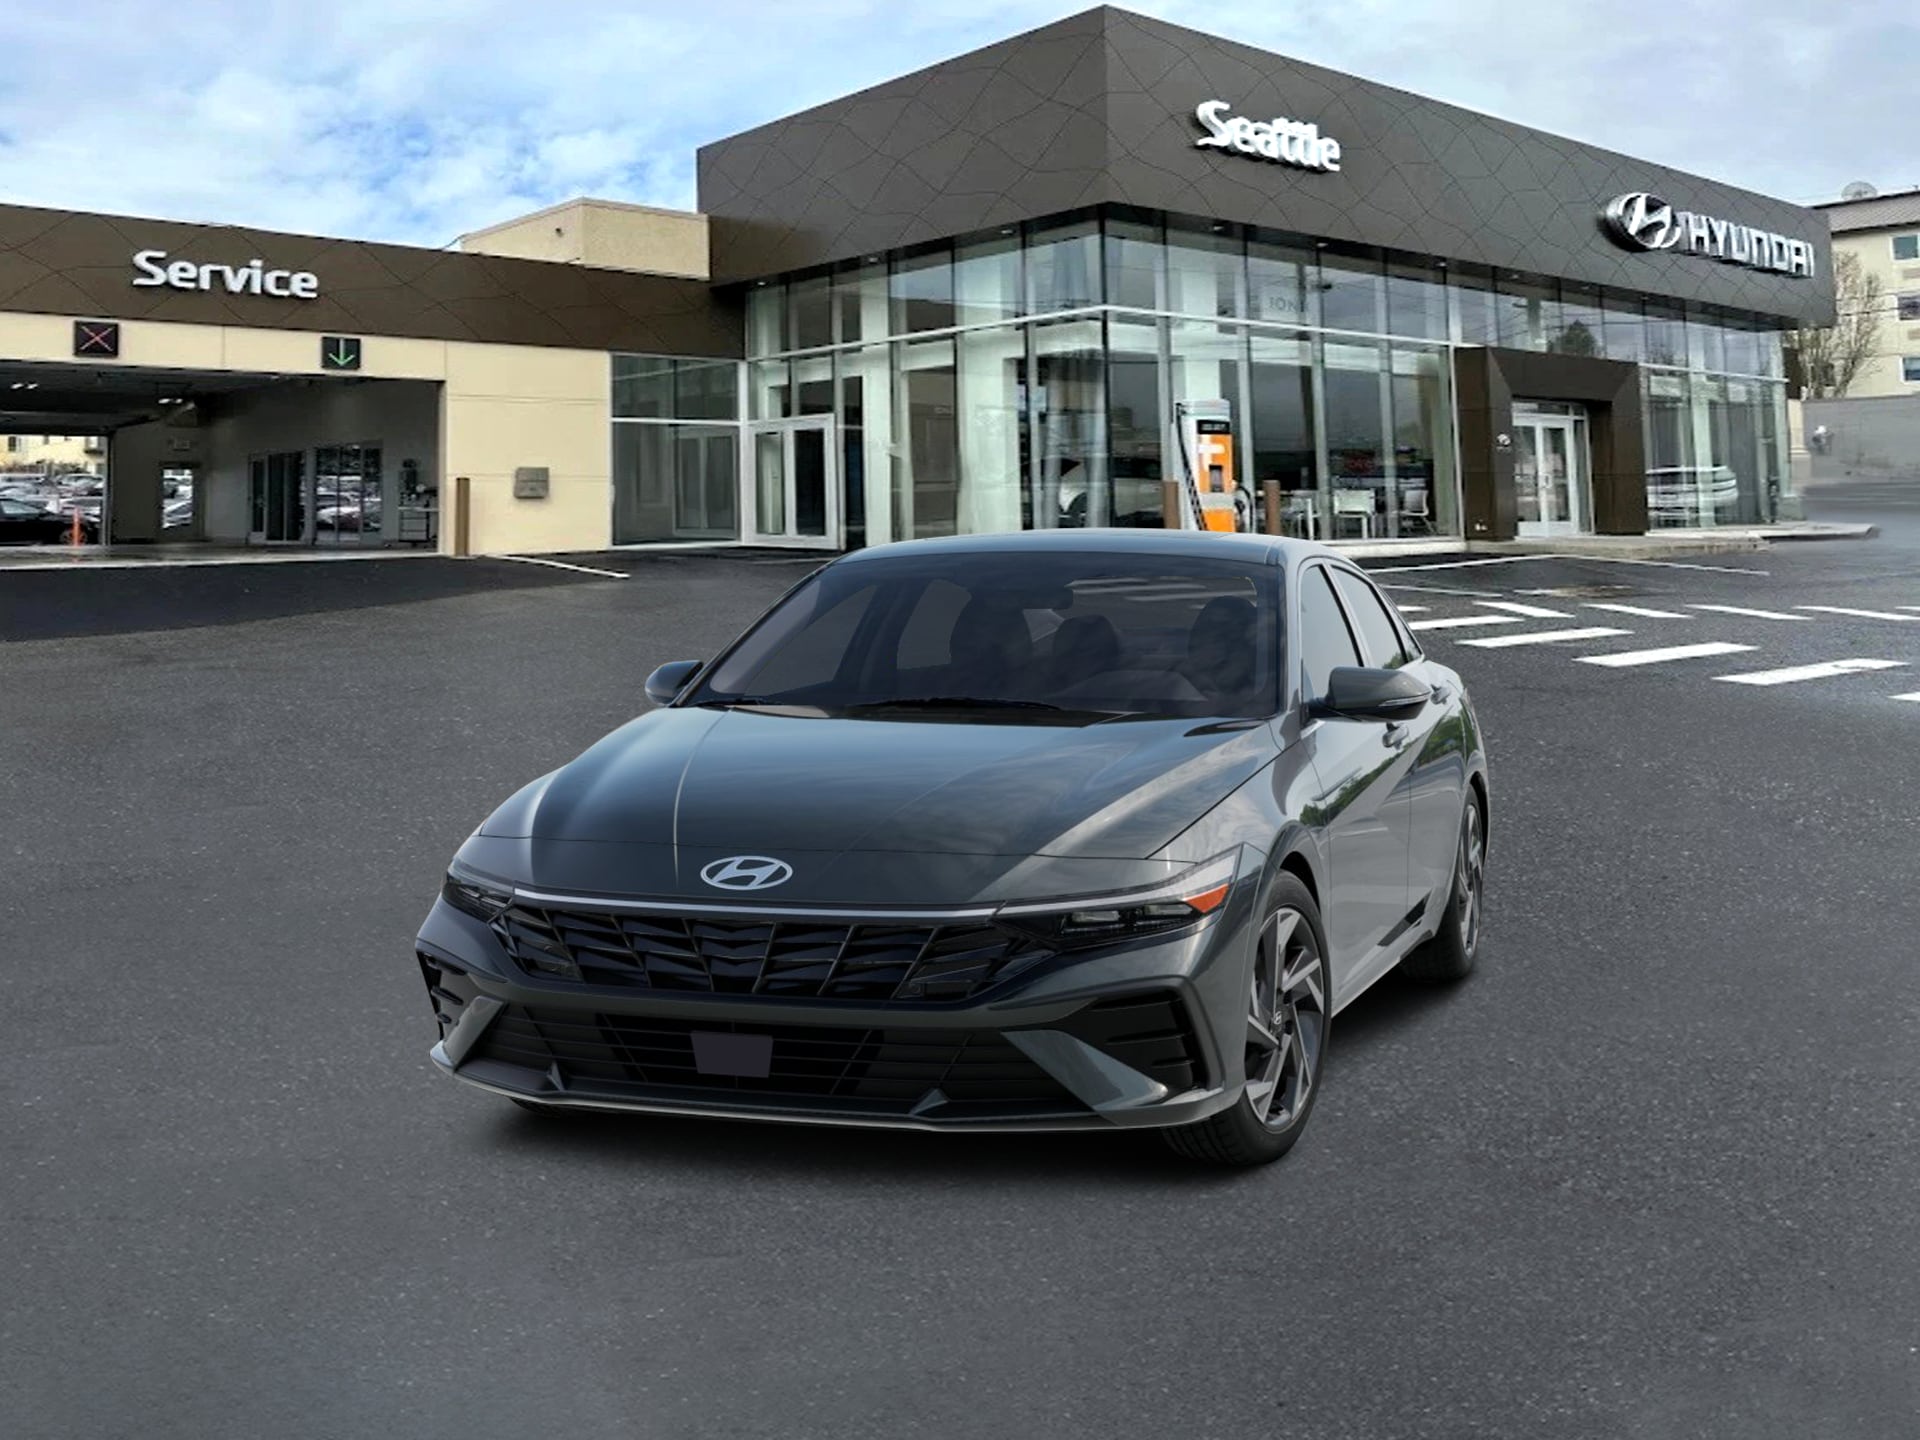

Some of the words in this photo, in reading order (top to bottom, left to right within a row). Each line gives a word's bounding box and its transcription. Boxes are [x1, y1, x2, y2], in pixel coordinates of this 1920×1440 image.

[1196, 100, 1341, 171] Seattle
[132, 250, 318, 298] Service
[1681, 212, 1815, 278] HYUNDAI
